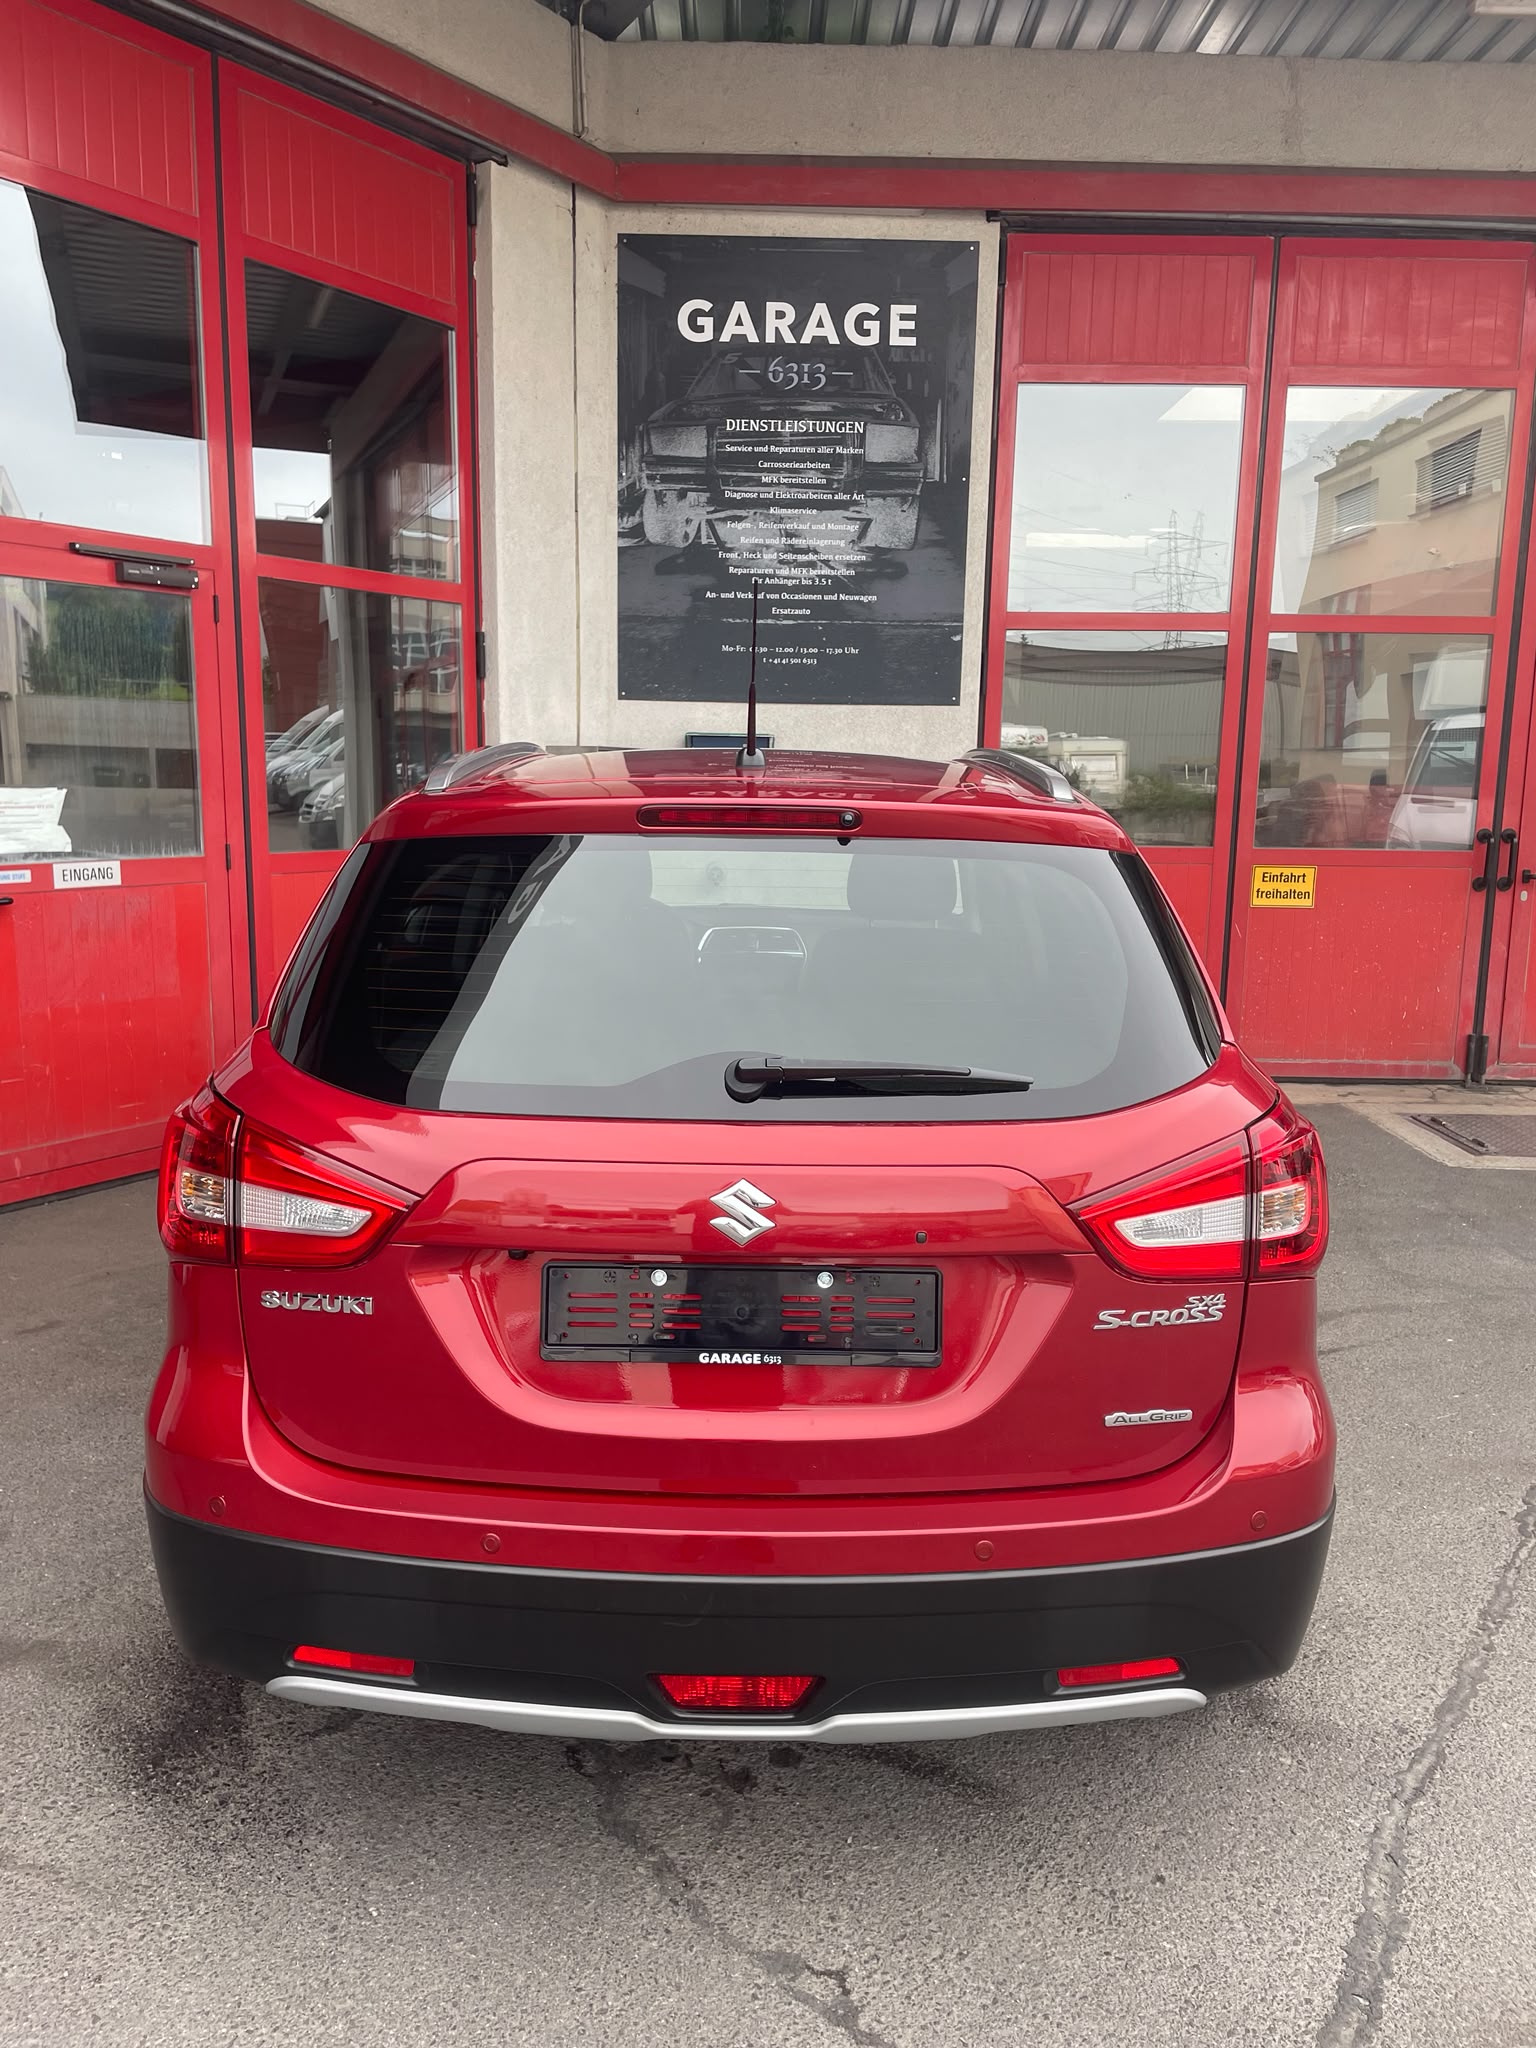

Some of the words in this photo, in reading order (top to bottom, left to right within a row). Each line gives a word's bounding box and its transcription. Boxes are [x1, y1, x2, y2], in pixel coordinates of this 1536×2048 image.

[677, 299, 917, 347] GARAGE
[767, 356, 826, 391] 6313
[725, 419, 864, 434] DIENSTLEISTUNGEN
[725, 444, 752, 452] Service
[770, 446, 815, 454] Reparaturen
[817, 446, 834, 454] aller
[758, 460, 830, 469] Carrosseriearbeiten
[761, 476, 779, 484] MFK
[780, 476, 826, 484] bereitstellen
[725, 490, 758, 499] Diagnose
[759, 491, 774, 499] und
[776, 492, 832, 500] Elektroarbeiten
[834, 492, 850, 500] aller
[852, 492, 864, 500] Art
[770, 507, 817, 515] Klimaservice
[758, 522, 810, 530] Reifenverkauf
[811, 522, 826, 530] und
[827, 523, 859, 532] Montage
[740, 536, 764, 544] Reifen
[781, 537, 846, 547] Rädereinlagerung
[718, 552, 741, 560] Front,
[763, 552, 777, 560] und
[778, 552, 833, 561] Seitenscheiben
[835, 553, 866, 561] ersetzen
[729, 567, 774, 576] Reparaturen
[775, 567, 790, 575] und
[790, 567, 808, 575] MFK
[809, 568, 855, 576] bereitstellen
[764, 577, 800, 586] Anhänger
[801, 577, 813, 585] bis
[814, 578, 826, 586] 3.5
[720, 591, 734, 599] und
[736, 591, 764, 599] Verkuf
[824, 593, 838, 601] und
[839, 594, 877, 602] Neuwagen
[772, 607, 811, 615] Ersatzauto
[62, 867, 114, 882] EINGANG
[1262, 871, 1306, 883] Einfahrt
[1256, 888, 1310, 900] freihalten
[260, 1290, 372, 1315] SUZUKI
[1184, 1293, 1226, 1308] SX4
[1093, 1304, 1226, 1330] S-CROSS
[699, 1353, 761, 1364] GARAGE
[763, 1354, 782, 1364] 6313
